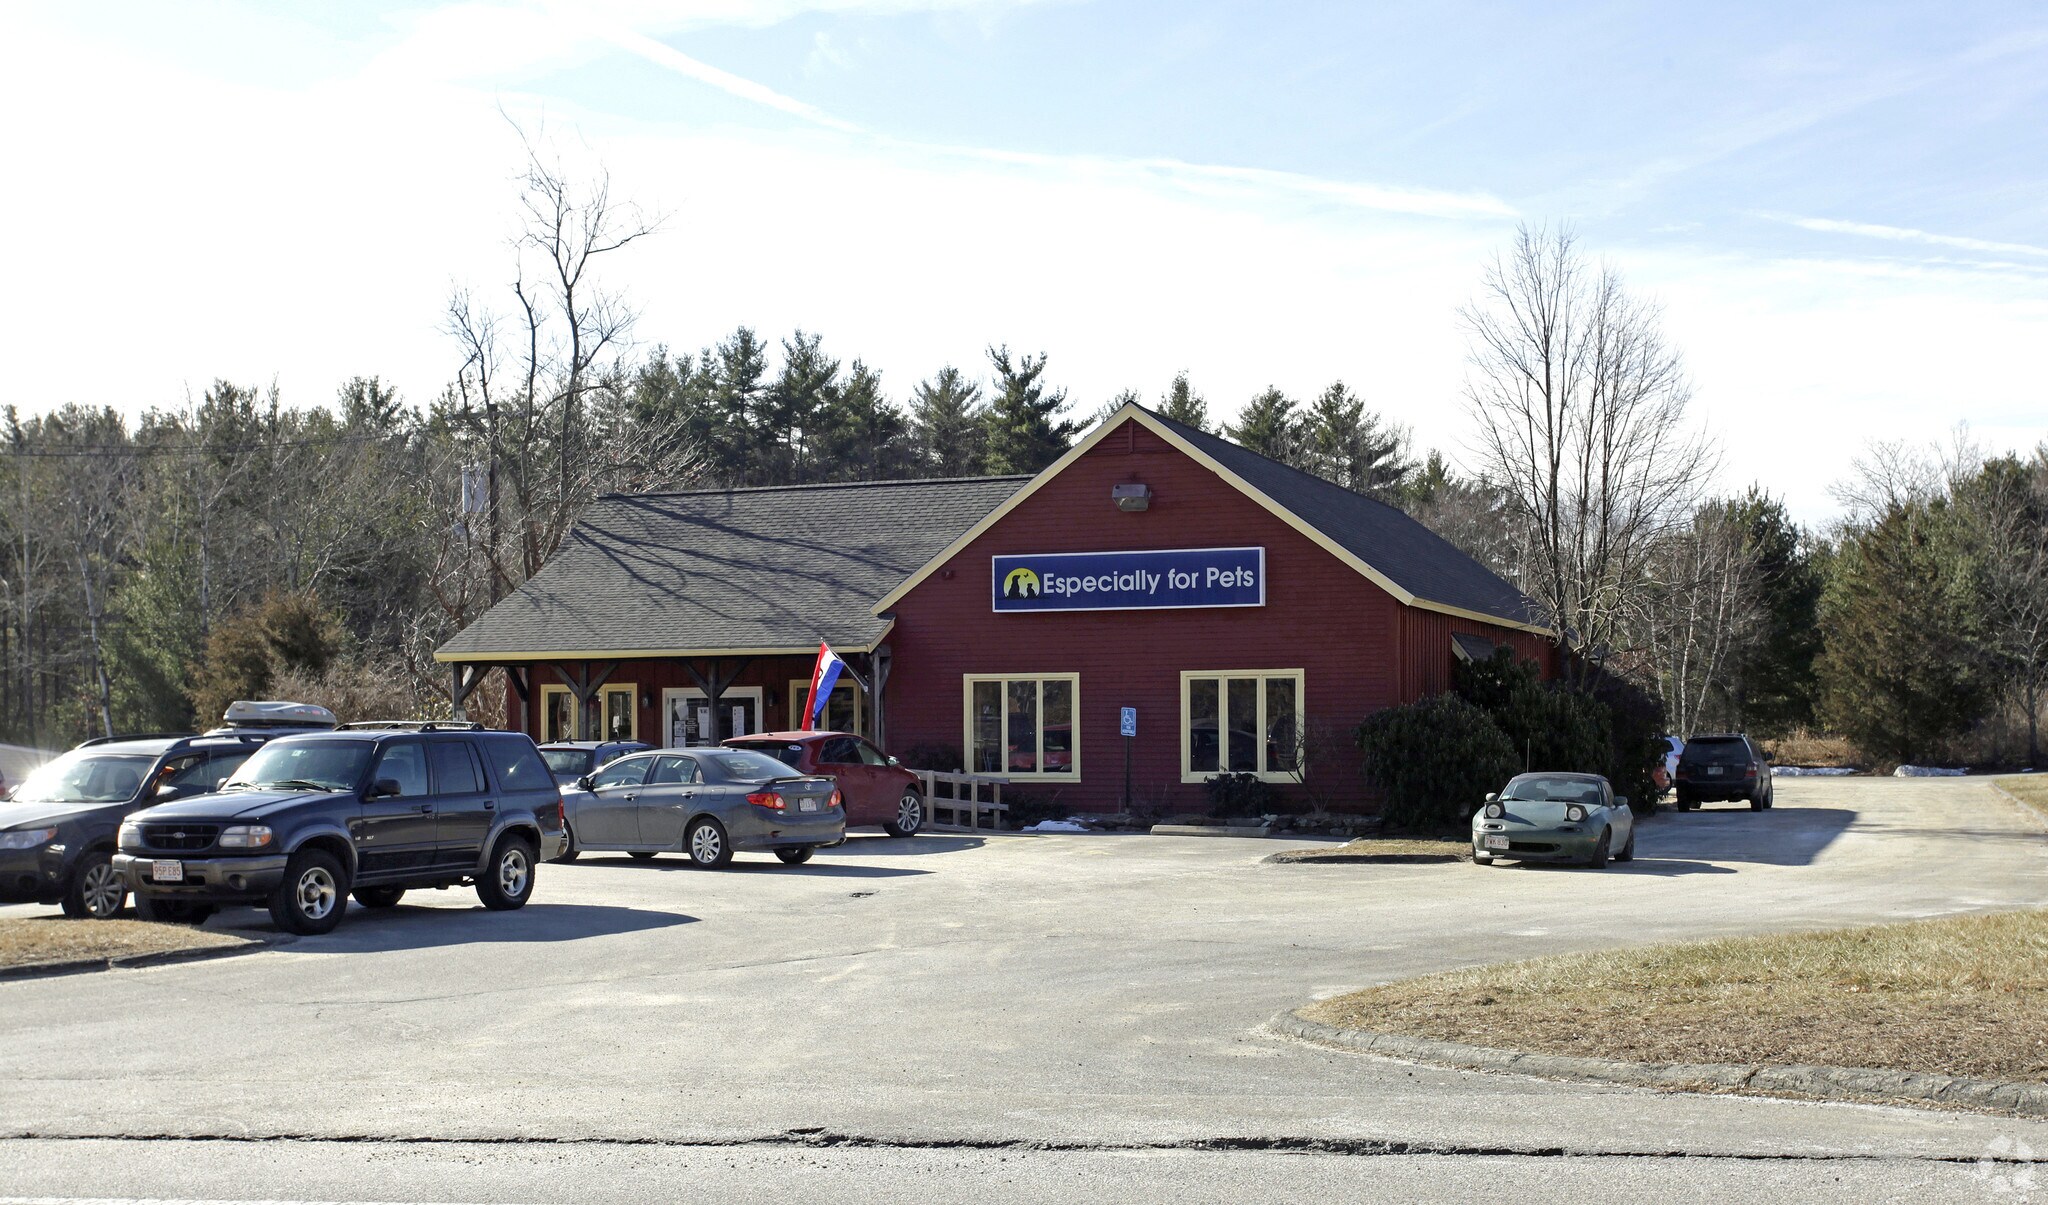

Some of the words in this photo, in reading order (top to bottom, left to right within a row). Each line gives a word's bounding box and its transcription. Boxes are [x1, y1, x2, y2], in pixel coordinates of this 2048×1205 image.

[1043, 569, 1161, 598] Especially
[1167, 568, 1199, 589] for
[1206, 566, 1254, 588] Pets
